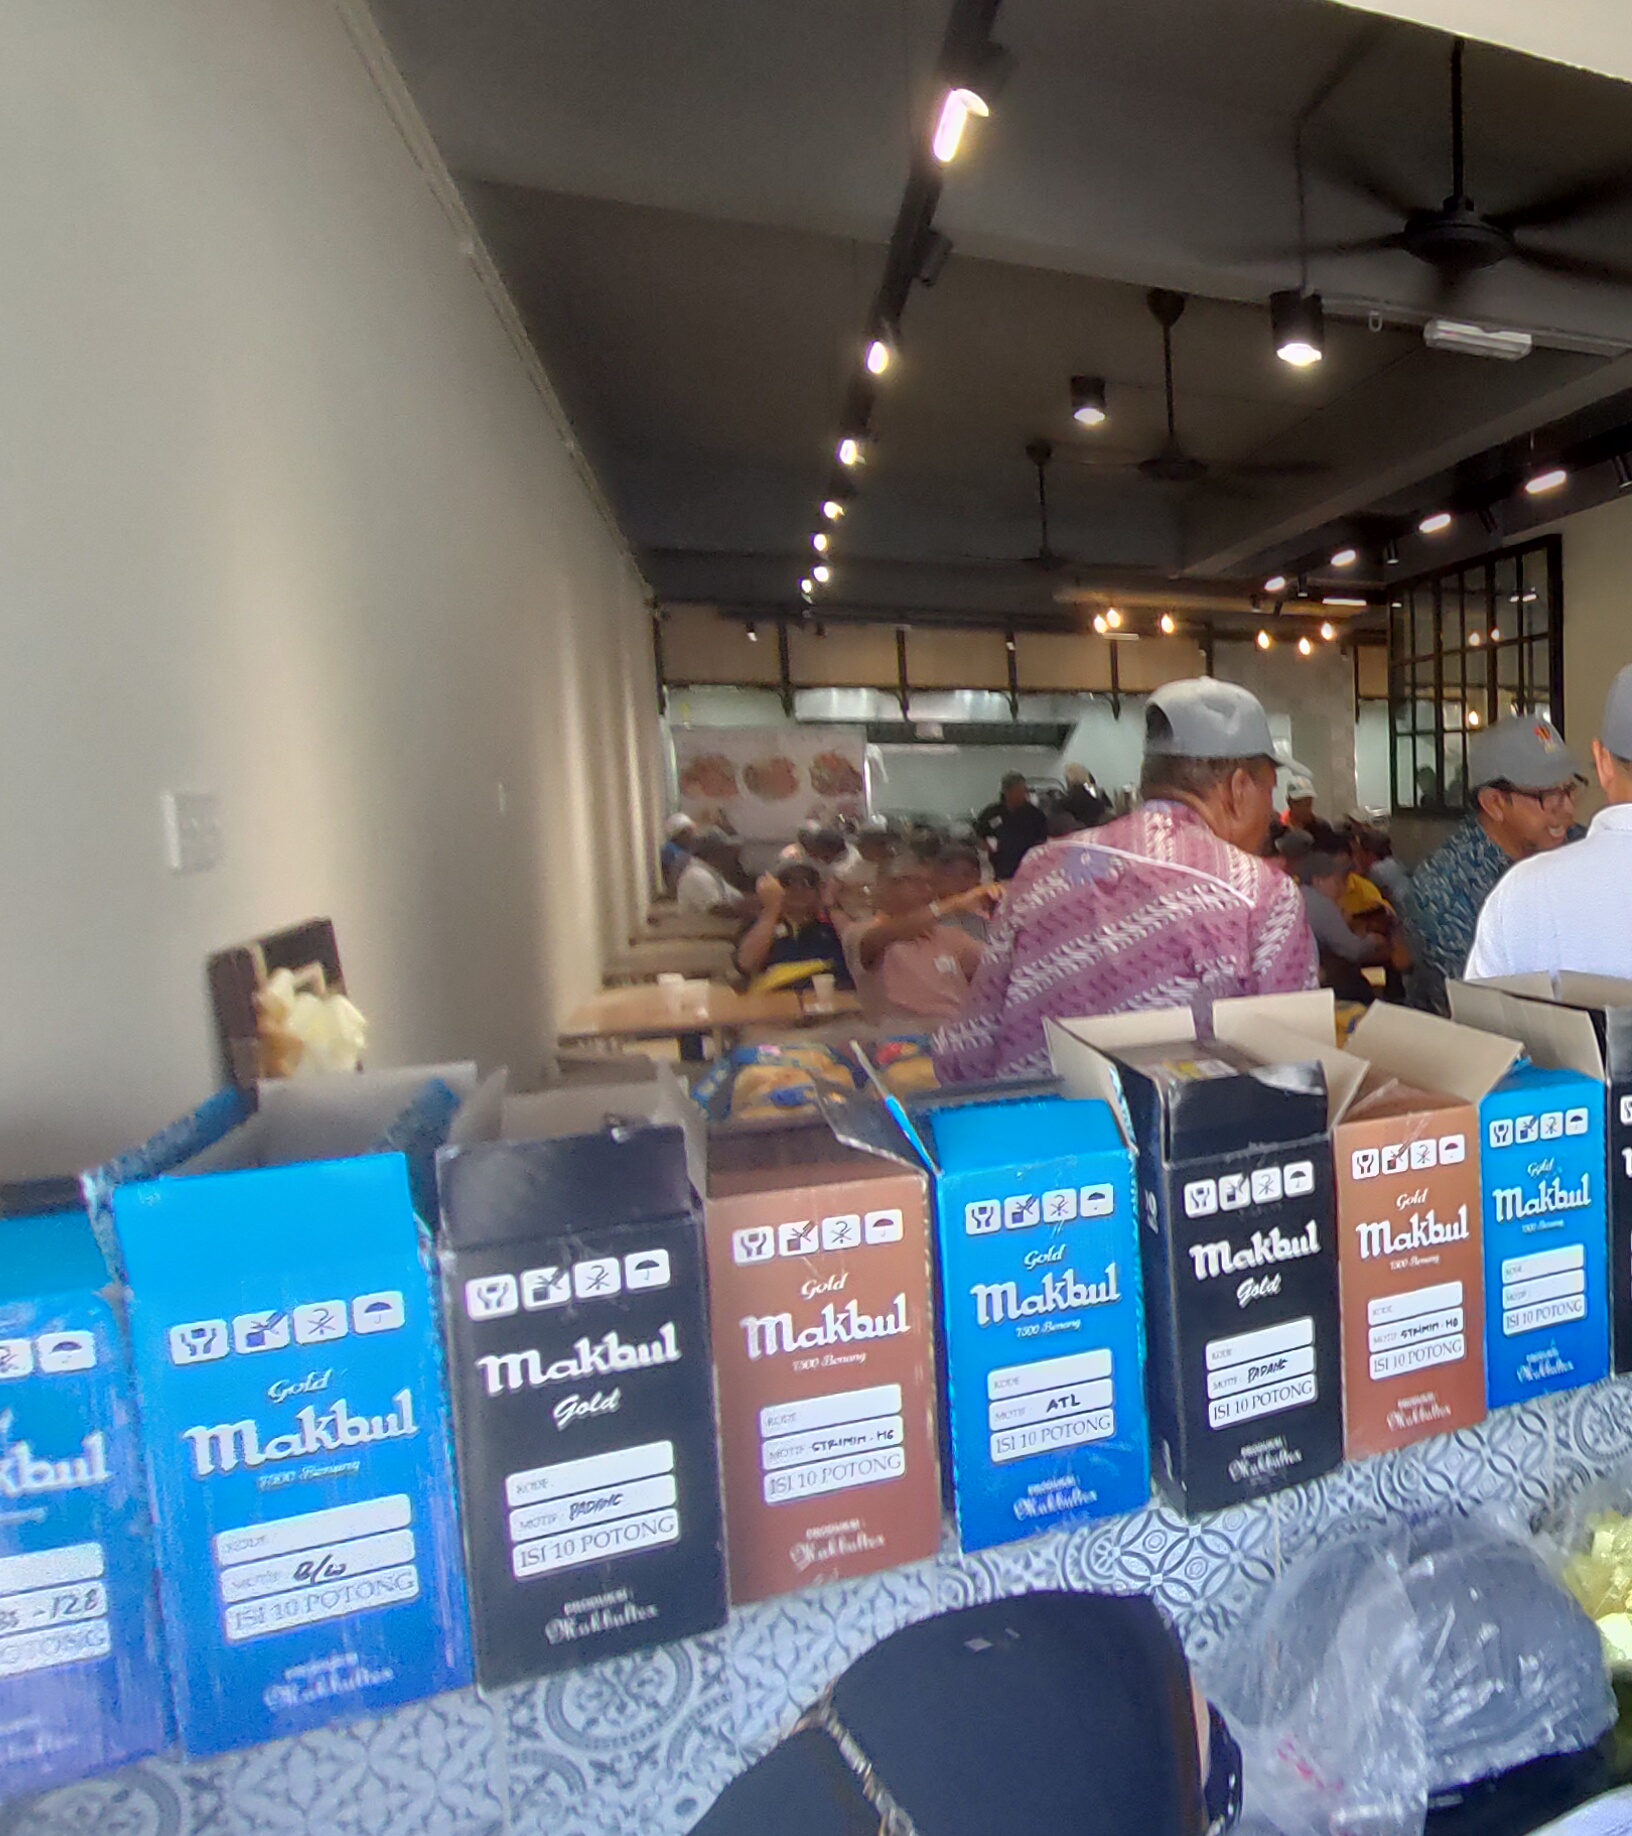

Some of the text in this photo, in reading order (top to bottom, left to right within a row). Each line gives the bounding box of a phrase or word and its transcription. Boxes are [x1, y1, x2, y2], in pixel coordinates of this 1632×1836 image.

[1396, 1187, 1429, 1211] Gold
[1492, 1172, 1592, 1223] Makbul
[1188, 1219, 1322, 1281] Makbul
[1355, 1203, 1470, 1259] Makbul
[1023, 1243, 1067, 1271] Gold
[801, 1272, 849, 1300] Gold
[969, 1261, 1122, 1328] Makbul
[1236, 1272, 1282, 1309] Gold
[739, 1292, 912, 1361] Makbul
[1506, 1299, 1583, 1330] ISI 10 POTONG
[474, 1320, 683, 1398] Makbul
[1374, 1339, 1463, 1373] ISI 10 POTONG
[267, 1368, 333, 1404] Gold
[1046, 1394, 1081, 1413] ATL
[1213, 1380, 1313, 1421] ISI 10 POTONG
[552, 1386, 622, 1431] Gold
[181, 1388, 420, 1476] Makbul
[996, 1414, 1112, 1454] ISI 10 POTONG
[769, 1453, 902, 1496] ISI 10 POTONG
[520, 1514, 676, 1568] ISI 10 POTONG
[305, 1571, 415, 1613] POTONG
